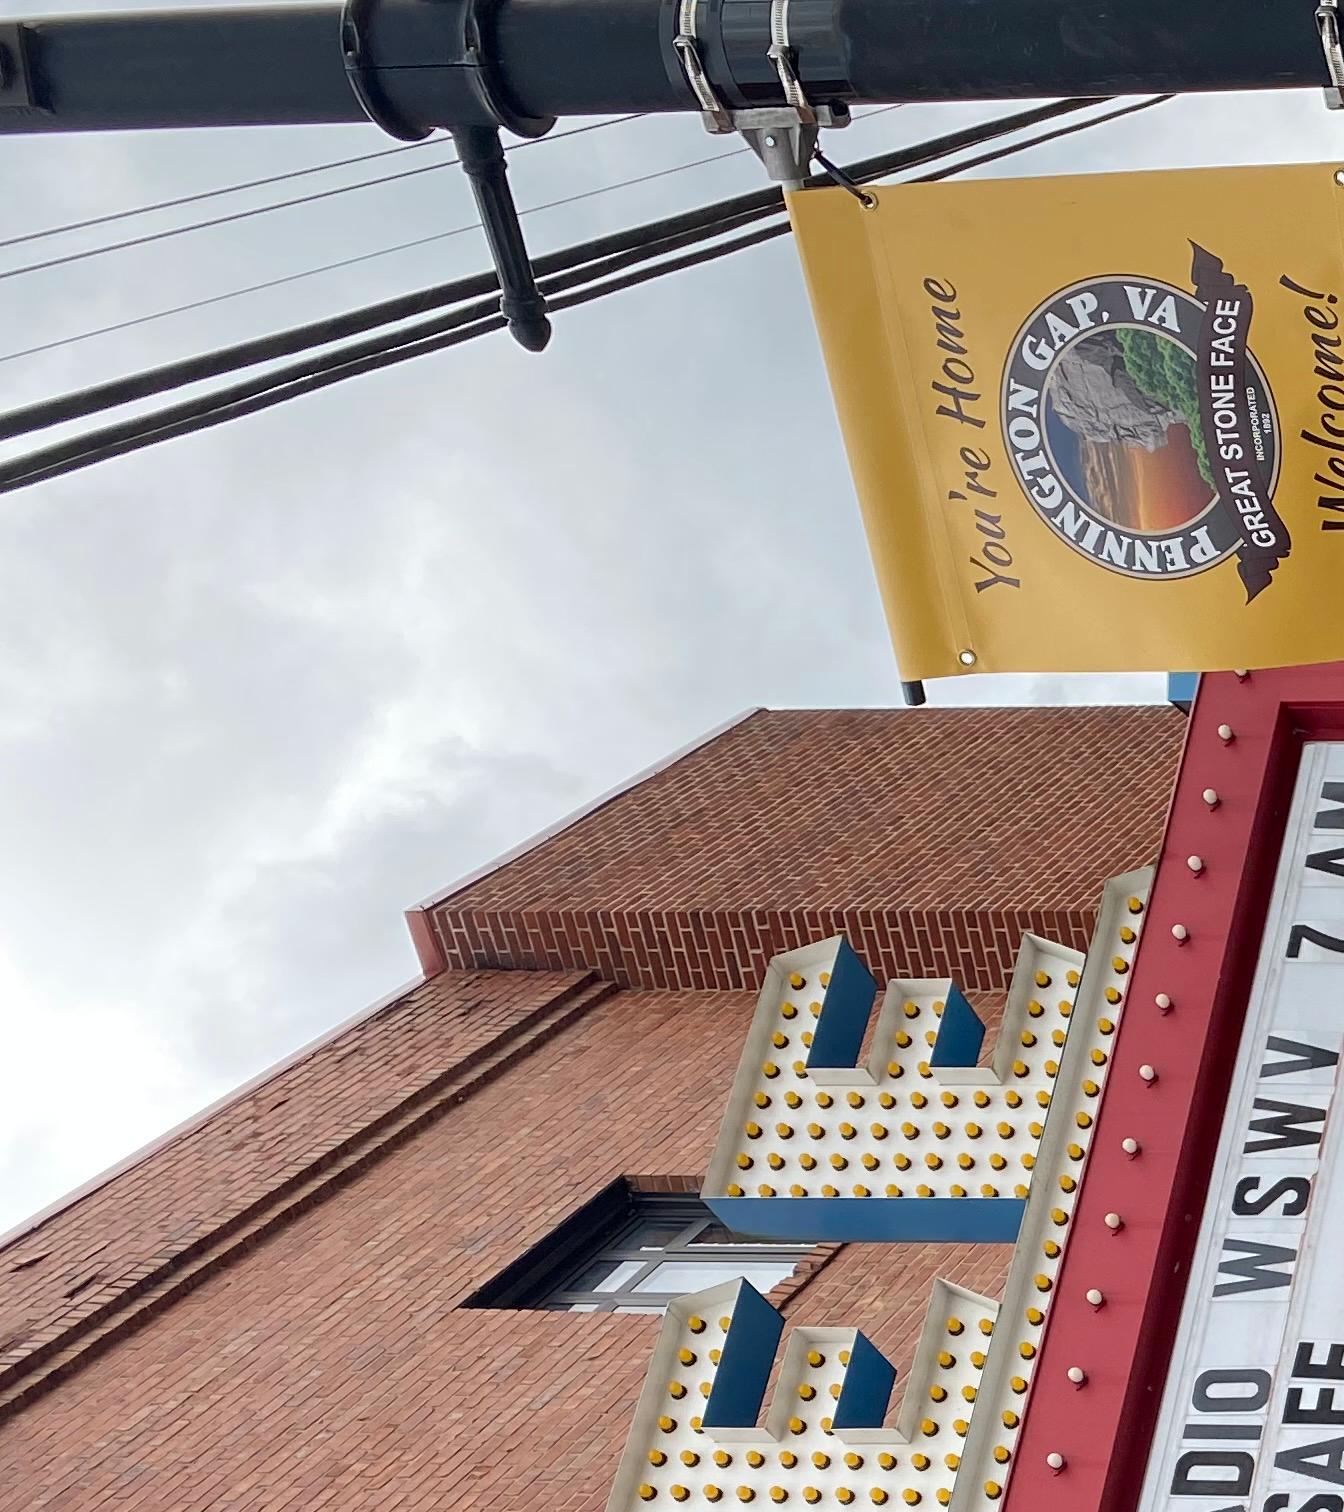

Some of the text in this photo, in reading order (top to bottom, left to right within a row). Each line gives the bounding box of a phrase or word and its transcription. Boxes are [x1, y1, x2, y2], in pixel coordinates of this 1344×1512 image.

[922, 277, 1020, 594] You're Home
[1007, 285, 1221, 572] PENNINGTON GAP, VA
[1210, 299, 1277, 548] GREAT STONE FACE
[1246, 387, 1266, 461] INCORPORATED
[1261, 413, 1272, 434] 1892
[1212, 1035, 1339, 1298] WSWV
